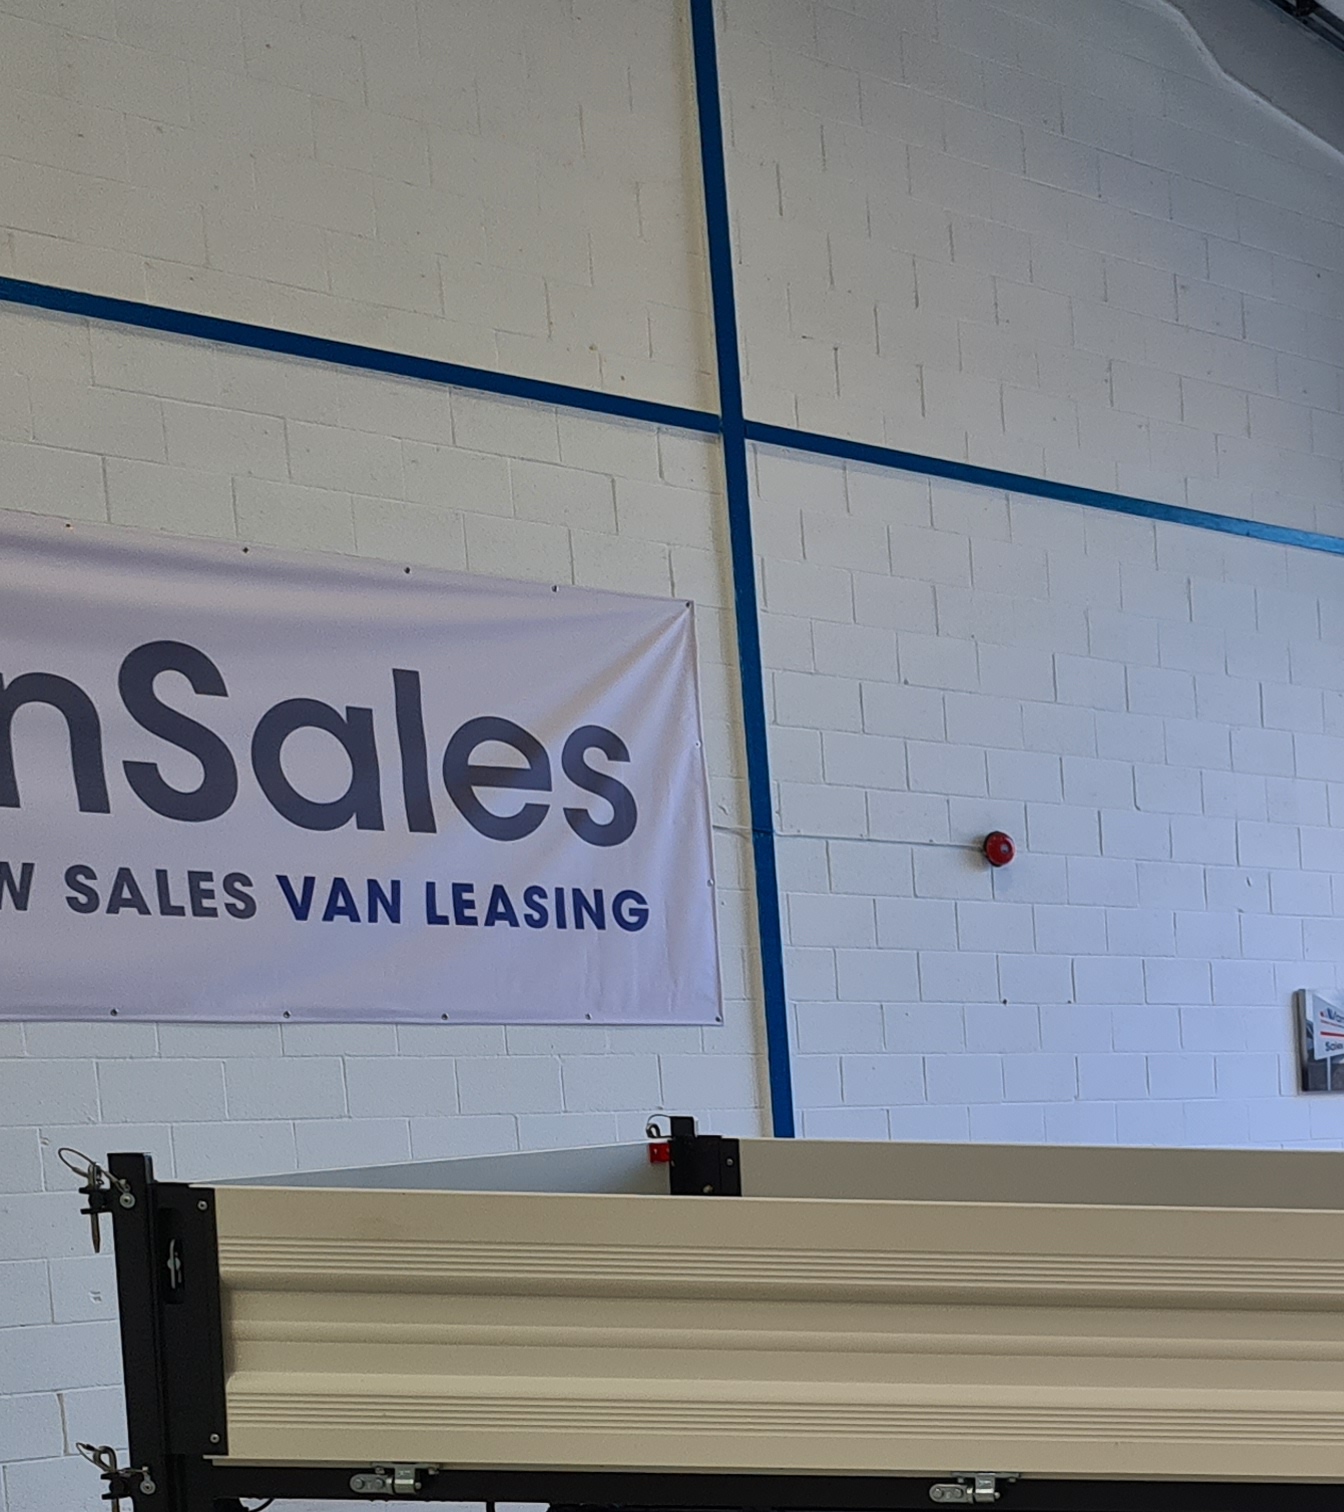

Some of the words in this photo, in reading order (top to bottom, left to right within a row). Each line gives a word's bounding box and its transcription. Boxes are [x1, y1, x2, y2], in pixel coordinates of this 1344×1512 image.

[0, 640, 640, 847] nSales
[64, 864, 257, 920] SALES
[276, 874, 402, 926] VAN
[426, 881, 650, 932] LEASING
